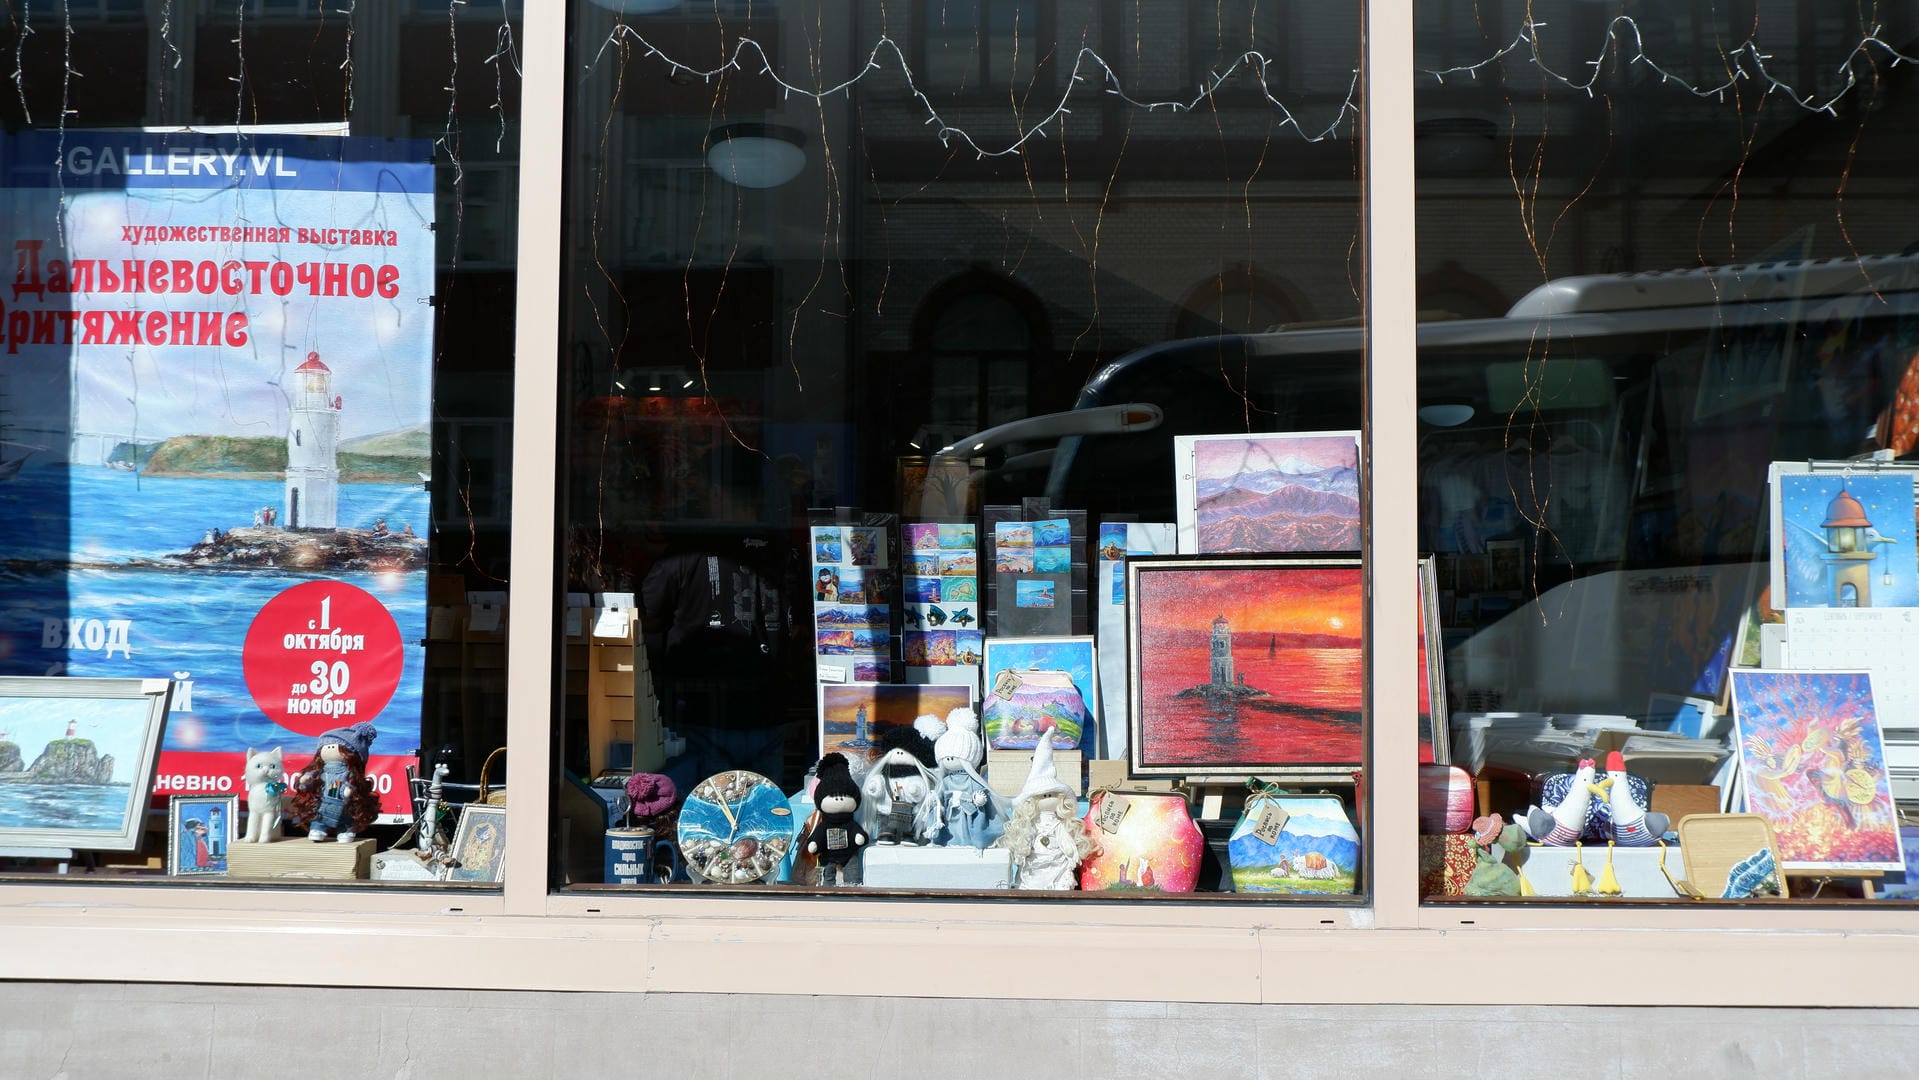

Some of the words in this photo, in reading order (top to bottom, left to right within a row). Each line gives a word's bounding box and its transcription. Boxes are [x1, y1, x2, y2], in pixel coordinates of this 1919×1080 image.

[67, 147, 297, 177] GALLERY.VL
[121, 225, 291, 246] художественная
[297, 227, 398, 247] выставка
[11, 240, 400, 303] Дальневосточное
[320, 595, 331, 630] 1
[283, 627, 365, 654] октября
[291, 683, 308, 696] до
[309, 660, 350, 695] 30
[287, 692, 356, 719] ноября
[152, 774, 232, 792] невно
